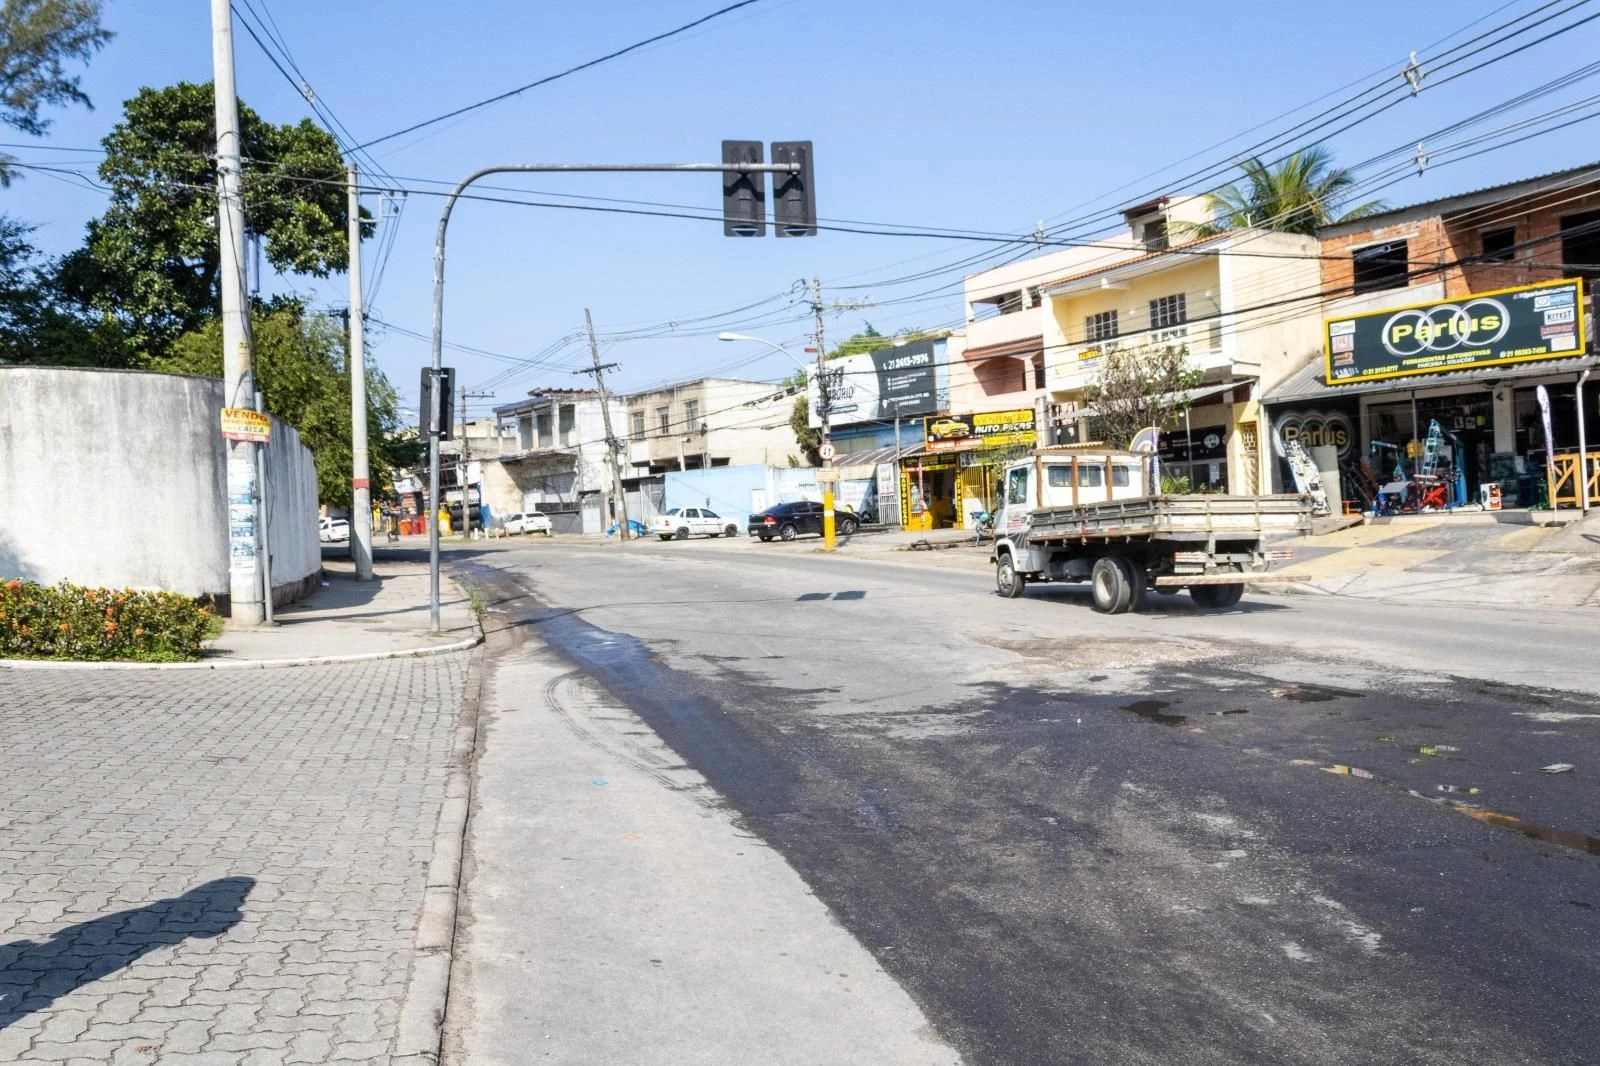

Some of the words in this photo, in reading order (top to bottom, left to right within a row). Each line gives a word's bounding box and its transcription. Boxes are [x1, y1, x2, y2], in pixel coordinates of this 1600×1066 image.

[1392, 315, 1501, 343] Parlus
[225, 410, 268, 422] VENDO
[974, 425, 999, 434] AUTO
[1285, 427, 1347, 446] Parlus
